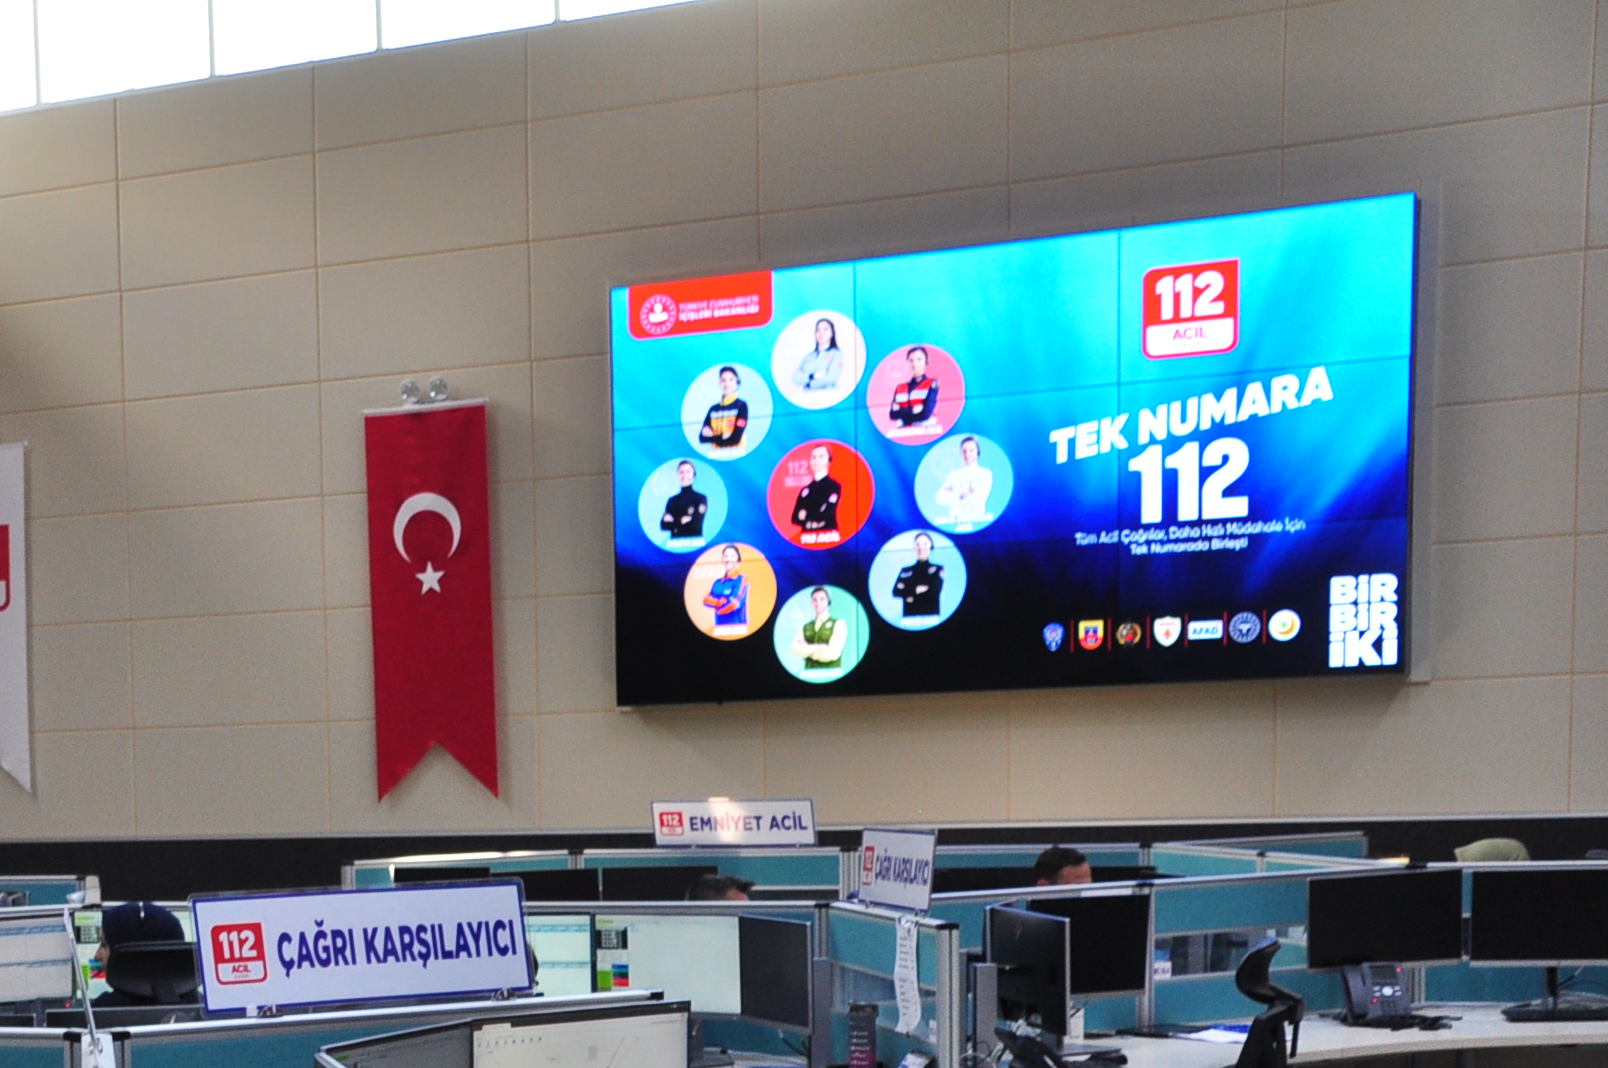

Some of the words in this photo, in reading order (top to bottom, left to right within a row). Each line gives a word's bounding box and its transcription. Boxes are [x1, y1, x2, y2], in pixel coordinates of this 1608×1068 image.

[1155, 270, 1225, 321] 112
[1049, 412, 1129, 464] TEK
[1137, 365, 1334, 445] NUMARA
[1128, 437, 1249, 524] 112
[662, 814, 680, 827] 112
[689, 812, 763, 832] EMNİYET
[769, 811, 808, 830] ACİL
[219, 929, 258, 959] 112
[277, 919, 357, 978] ÇAĞRI
[362, 919, 518, 969] KARŞILAYICI
